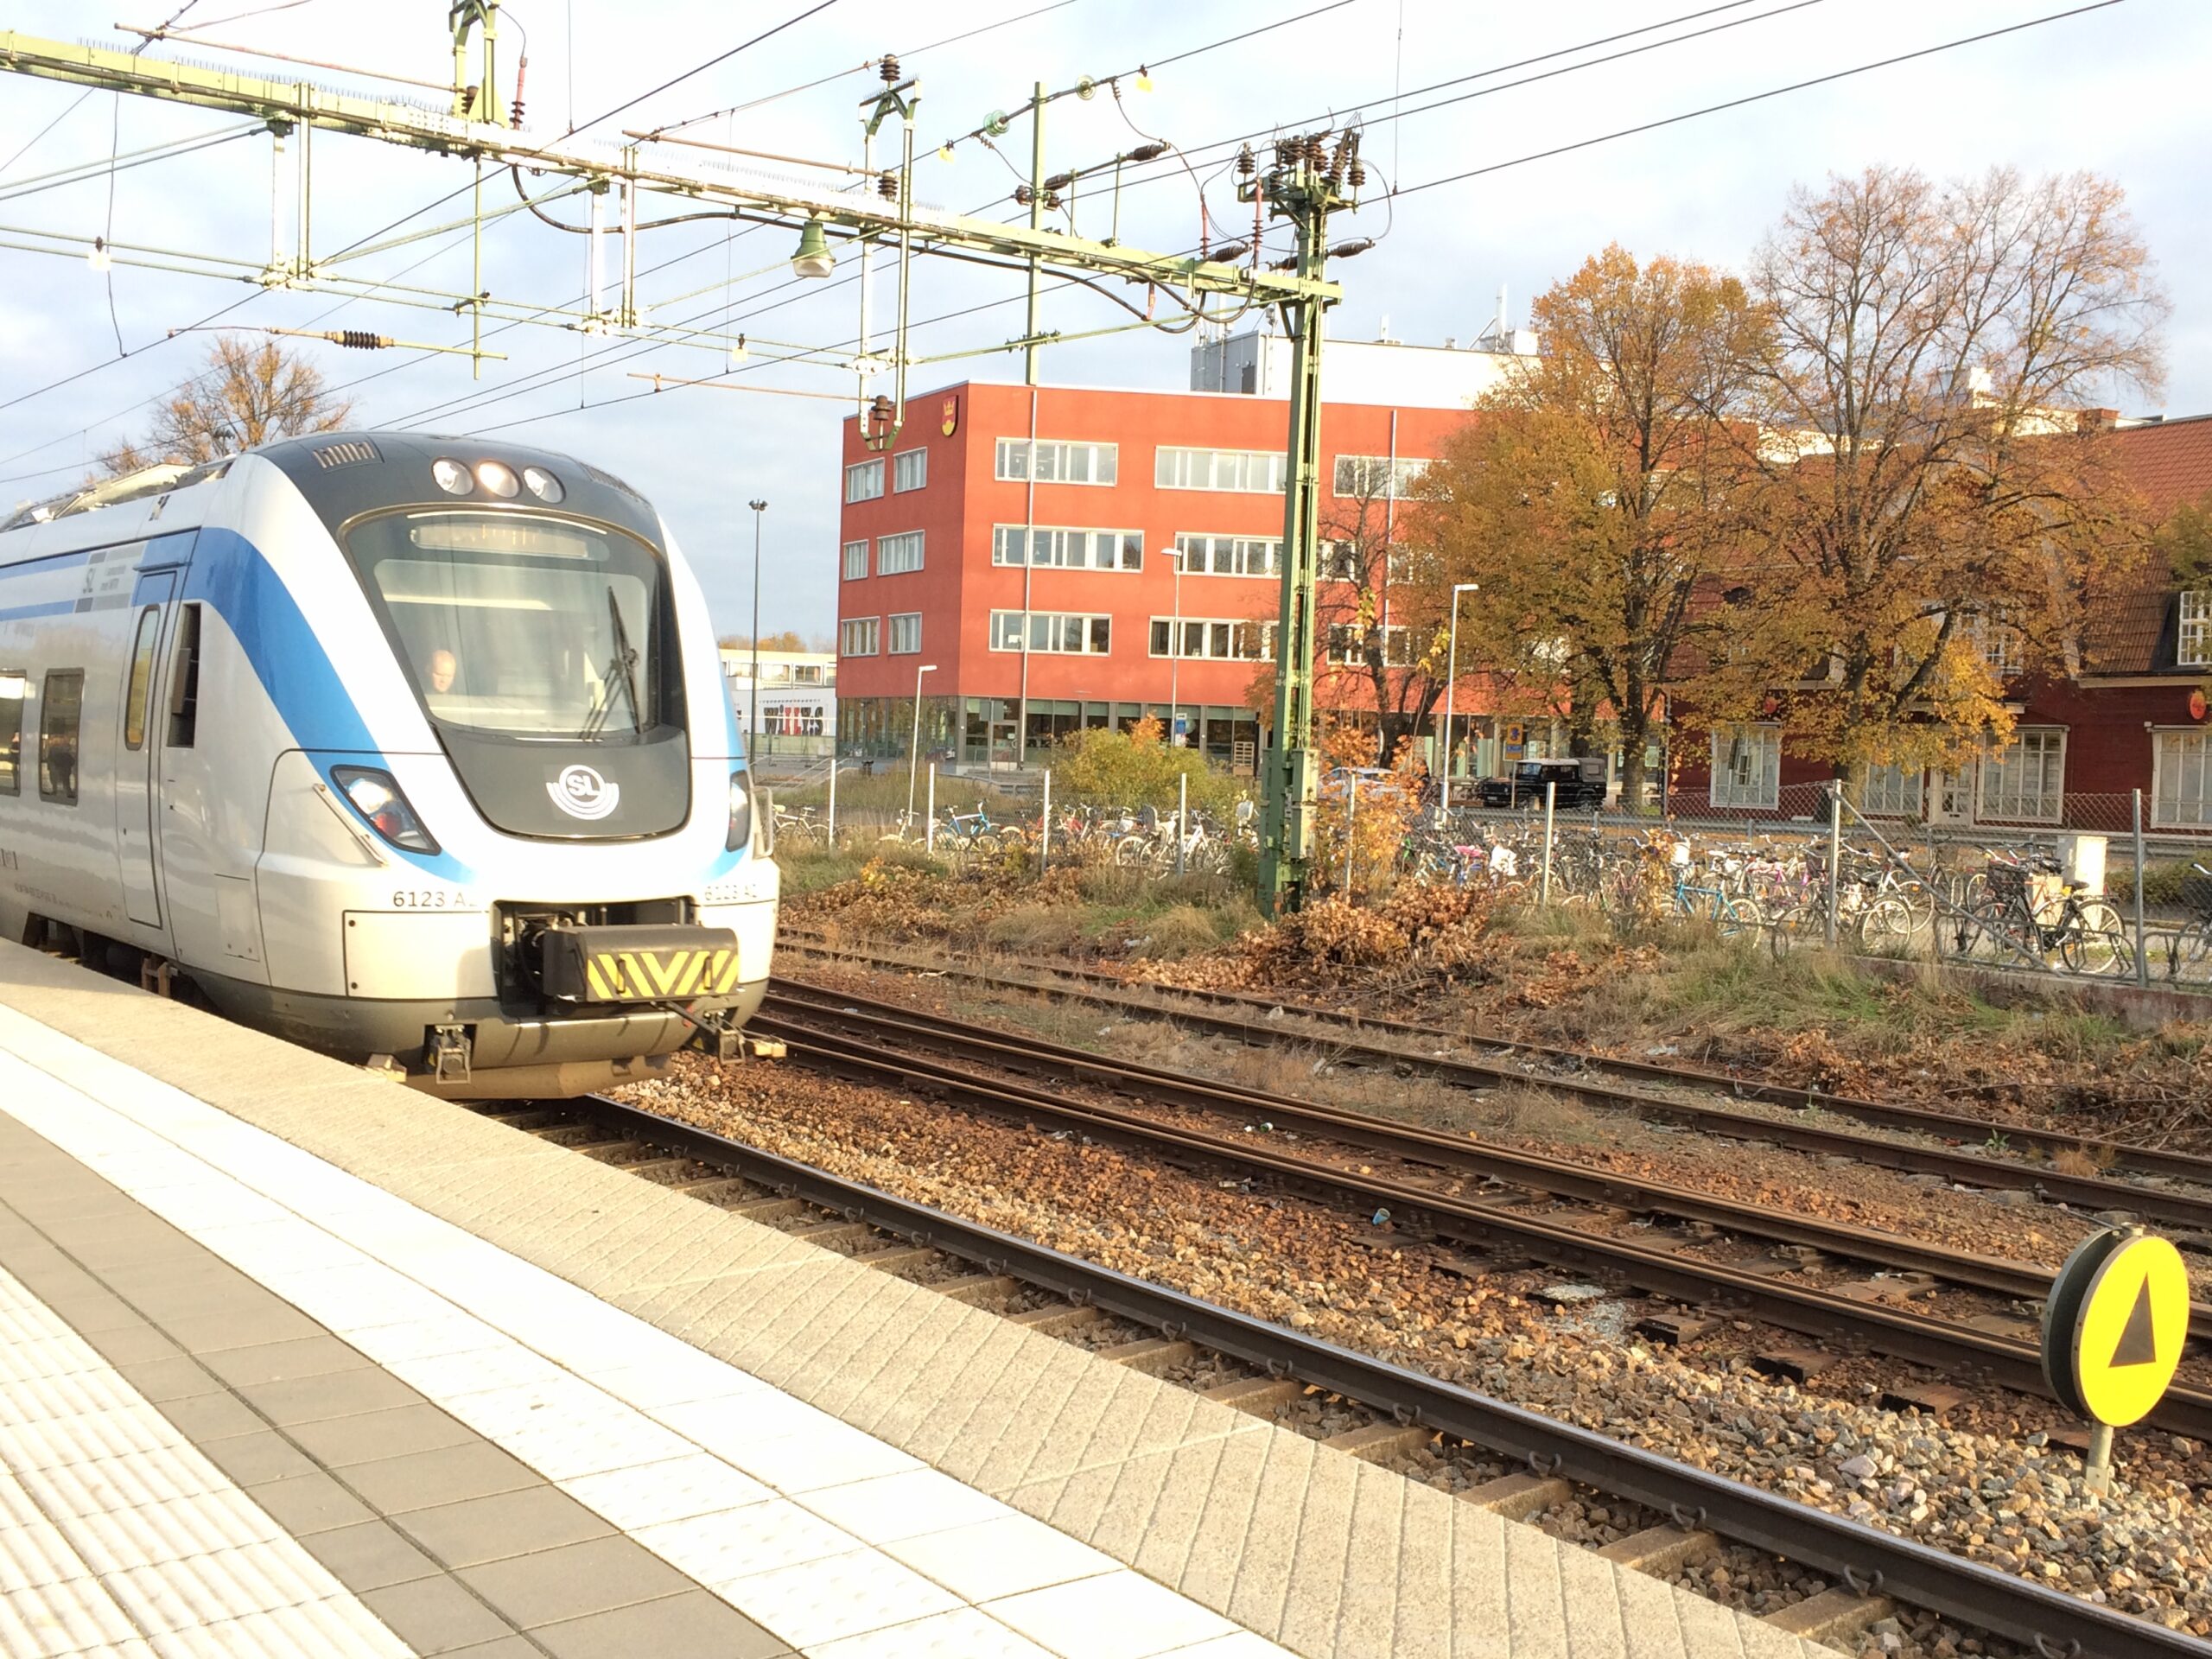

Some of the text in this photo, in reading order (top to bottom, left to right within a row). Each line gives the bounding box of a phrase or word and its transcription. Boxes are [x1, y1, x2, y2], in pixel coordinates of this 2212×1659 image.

[566, 774, 601, 797] SL
[392, 891, 478, 907] 6123 A
